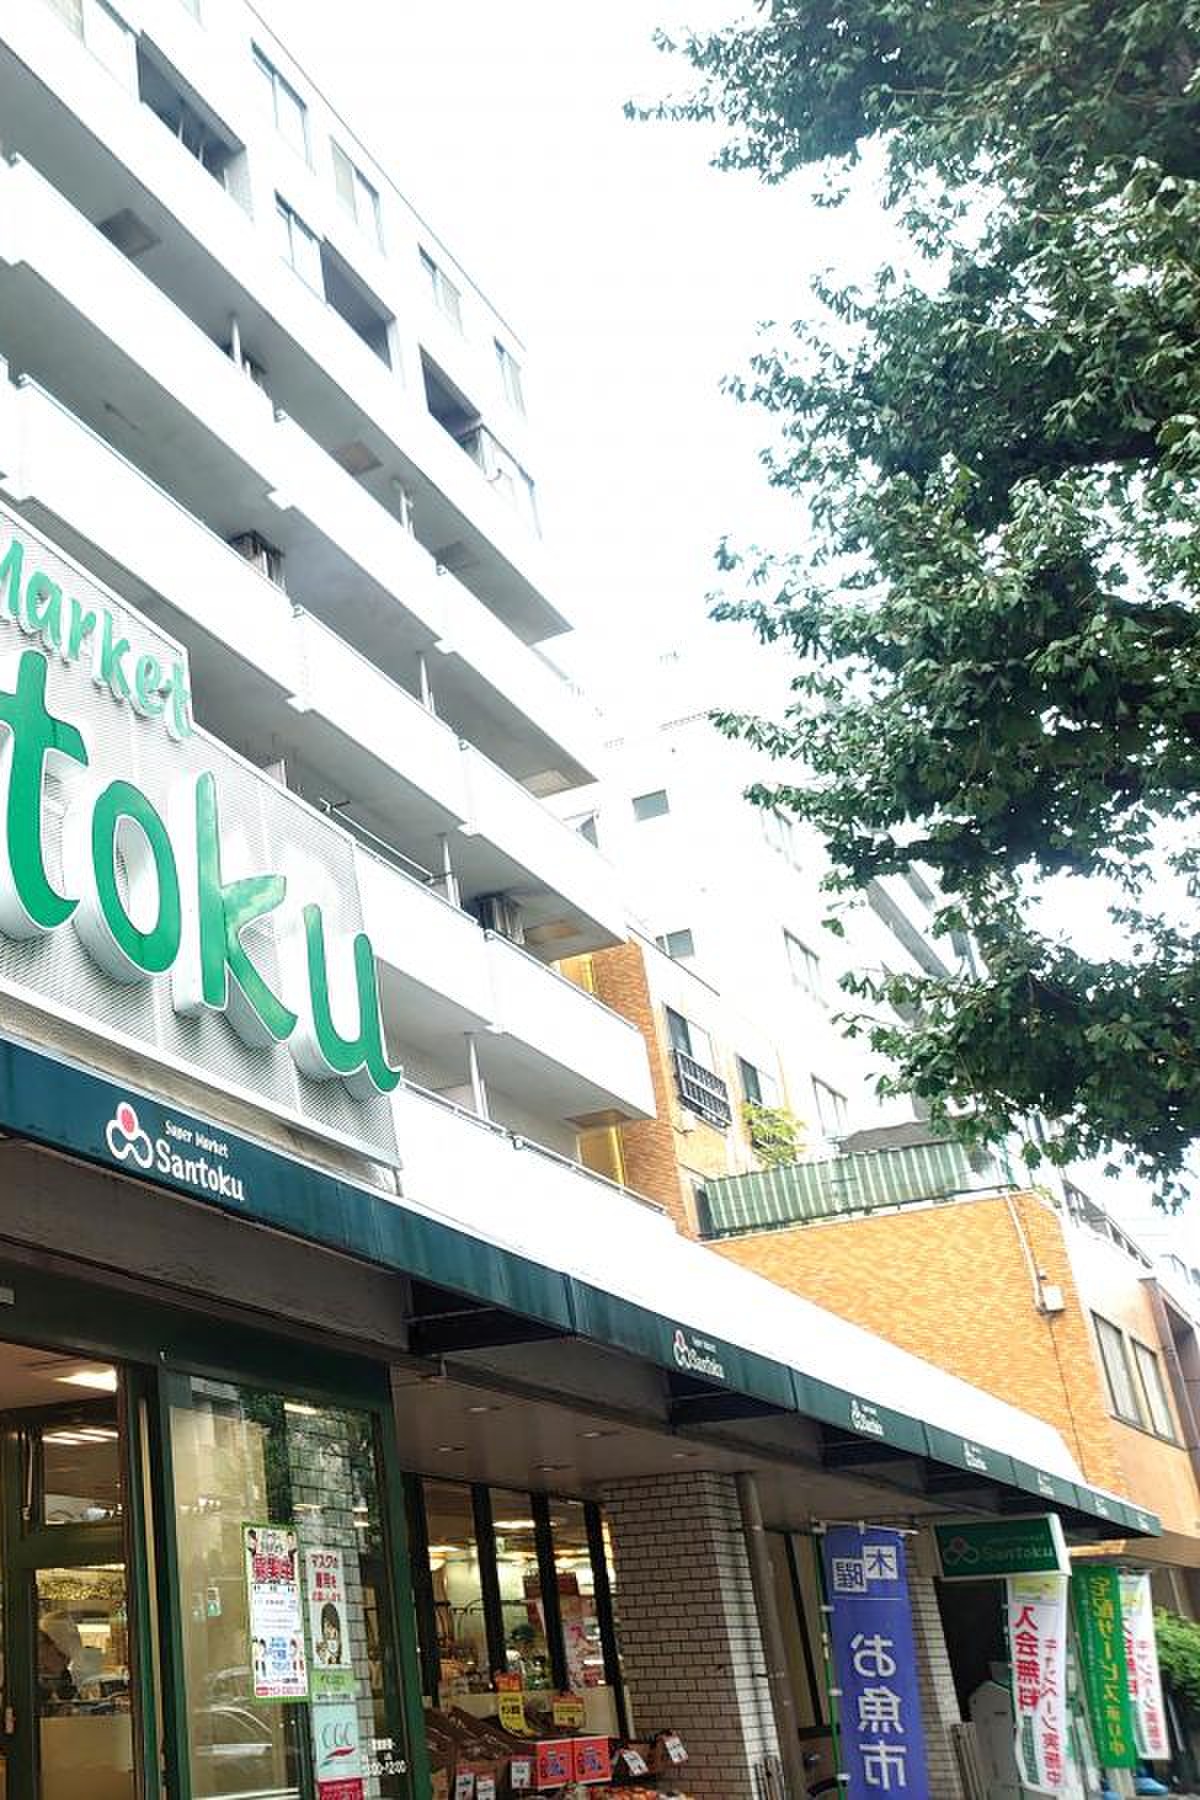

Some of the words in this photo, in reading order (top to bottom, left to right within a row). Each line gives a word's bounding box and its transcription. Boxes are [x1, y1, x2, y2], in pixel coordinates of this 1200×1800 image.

[165, 1120, 193, 1143] Super
[194, 1131, 229, 1159] Market
[155, 1138, 245, 1201] Santoku
